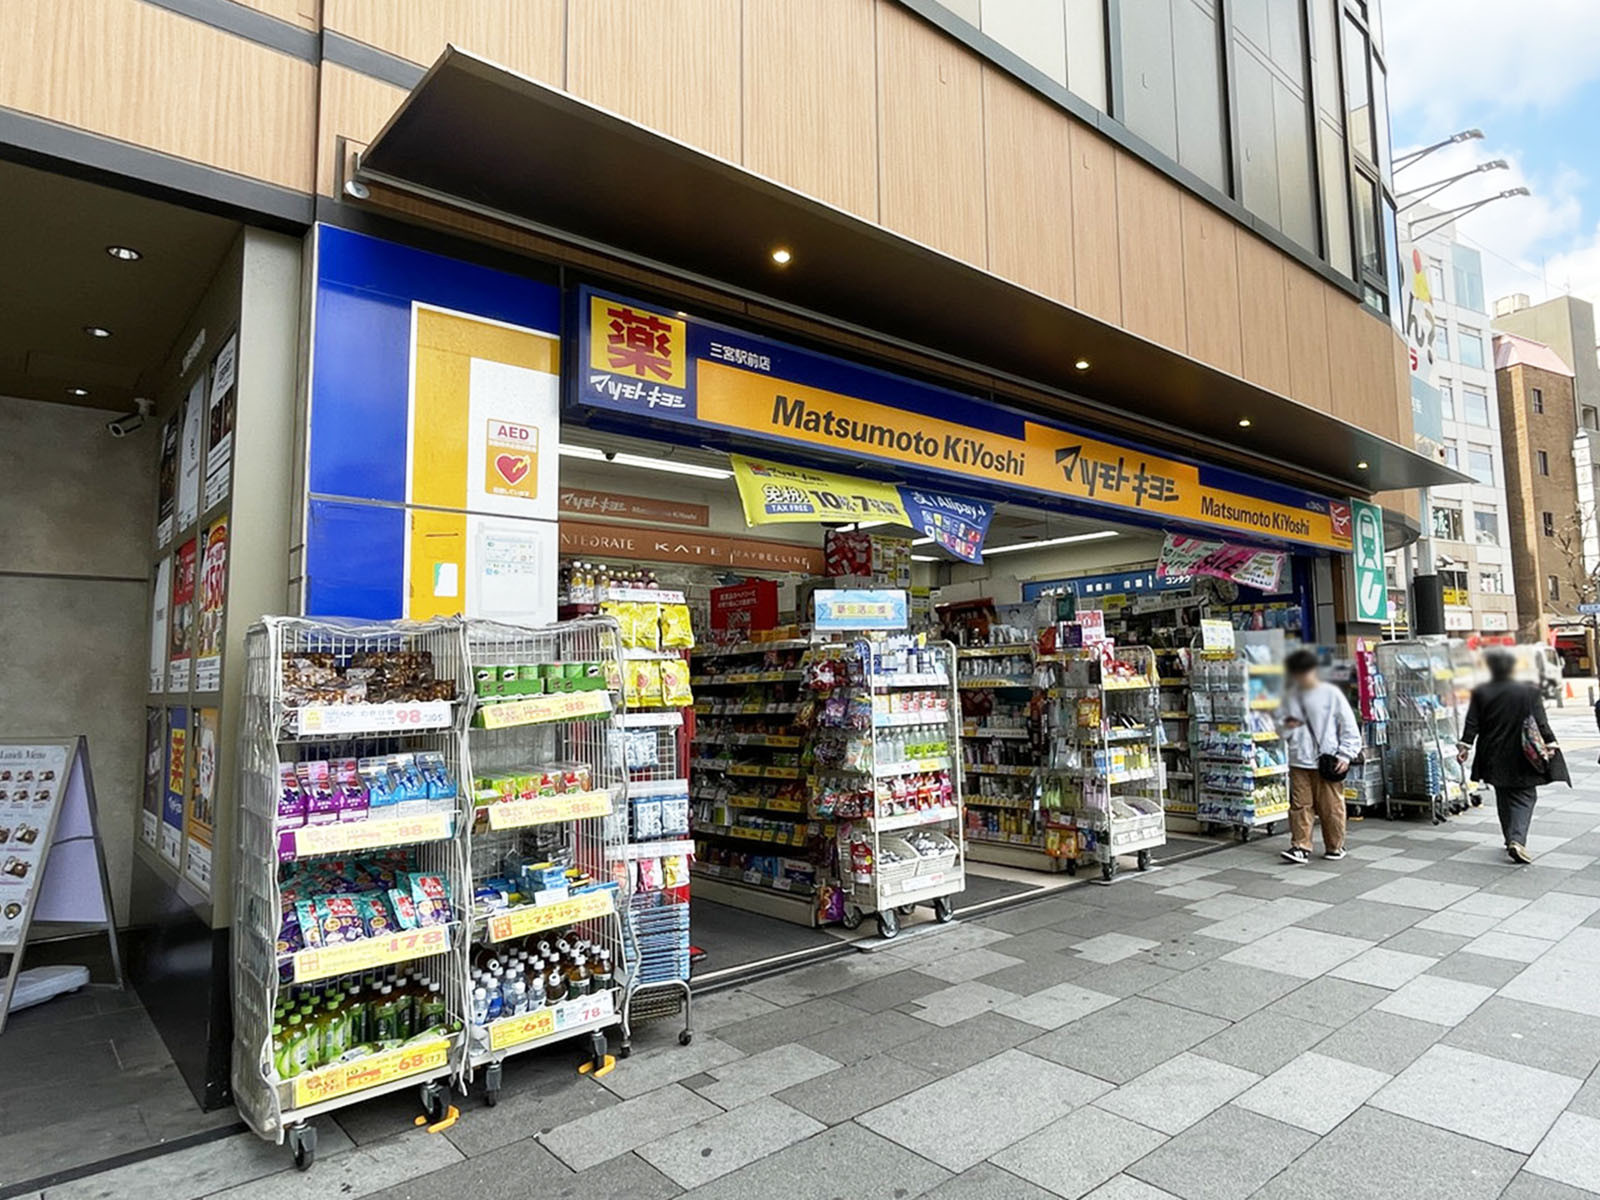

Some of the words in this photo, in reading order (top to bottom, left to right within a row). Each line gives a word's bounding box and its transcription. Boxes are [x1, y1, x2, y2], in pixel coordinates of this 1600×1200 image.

[607, 307, 673, 381] 薬
[710, 341, 771, 372] 三宮駅前店
[590, 374, 686, 408] マツモトキヨシ
[497, 424, 530, 440] AED
[771, 395, 938, 458] Matsumoto
[942, 434, 1026, 477] KiYoshi
[1055, 445, 1180, 507] マツモトキヨシ
[771, 504, 790, 512] TAX
[790, 505, 809, 513] FREE
[1200, 496, 1271, 529] Matsumoto
[1272, 511, 1310, 537] KiYoshi
[395, 709, 421, 724] 98
[390, 930, 433, 953] 178
[399, 1053, 425, 1070] 68
